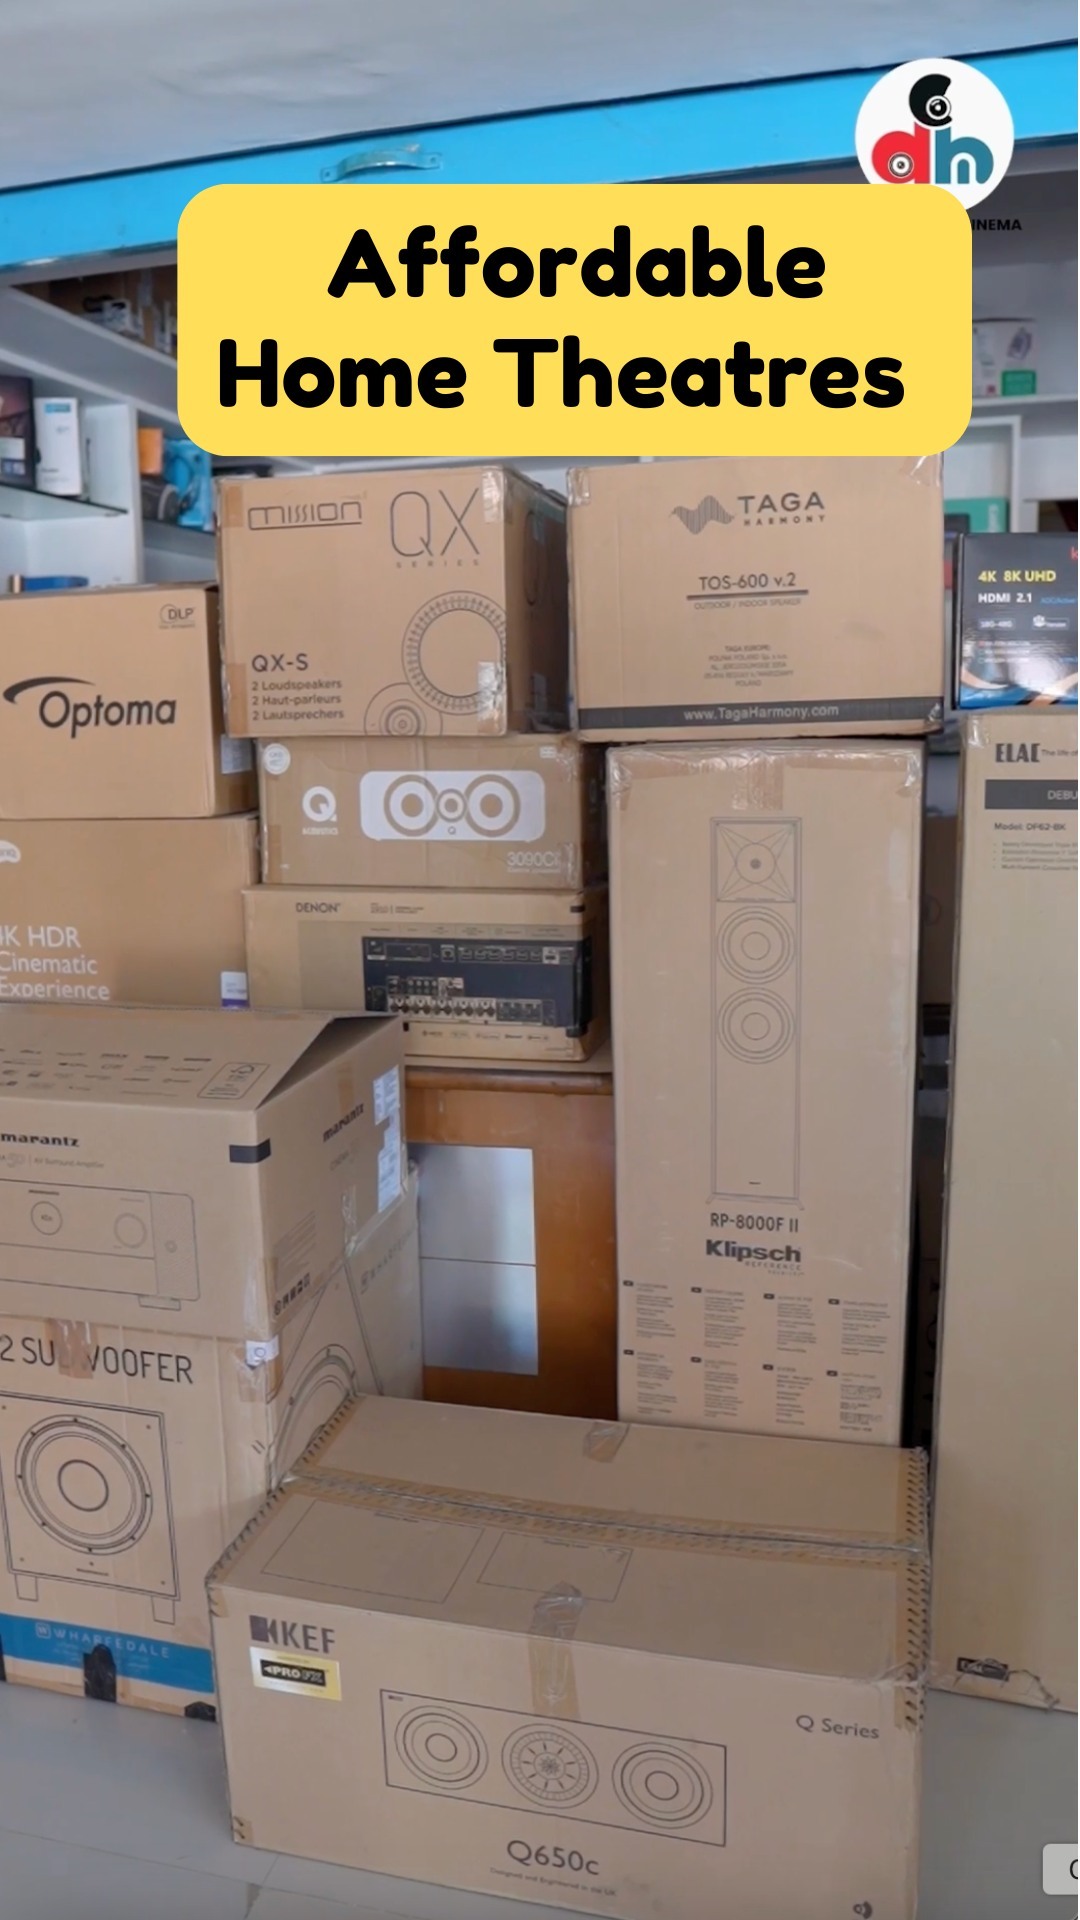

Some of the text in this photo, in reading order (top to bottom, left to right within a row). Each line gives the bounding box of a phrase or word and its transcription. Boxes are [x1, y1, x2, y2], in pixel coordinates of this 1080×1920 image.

[737, 491, 825, 514] TAGA
[247, 501, 364, 531] mission
[390, 487, 480, 557] QX
[743, 515, 825, 526] HARMONY
[396, 558, 480, 569] SERIES
[698, 572, 796, 591] TOS-600 v.2
[978, 570, 1057, 582] 4K 8K UHD
[694, 601, 731, 611] OUTDOOR
[738, 599, 768, 608] INDOOR
[770, 598, 802, 607] SPEAKER
[978, 592, 1011, 603] HDMI
[1016, 592, 1032, 603] 2.1
[168, 607, 194, 620] DLP
[252, 653, 309, 673] QX-S
[252, 679, 342, 693] 2 Loudspeakers
[252, 693, 342, 708] 2 Haut-parleurs
[39, 690, 176, 739] Optoma
[252, 708, 345, 722] 2 Lautsprechers
[683, 706, 839, 721] www.TagaHarmony.com
[1042, 749, 1055, 757] The
[302, 786, 337, 822] Q
[994, 823, 1023, 831] Model:
[295, 902, 337, 914] DENON
[28, 925, 81, 948] HDR
[0, 951, 98, 974] Cinematic
[0, 977, 110, 1001] Experience
[322, 1102, 365, 1144] marantz
[0, 1132, 80, 1148] marantz
[710, 1212, 784, 1232] RP-8000F
[705, 1239, 801, 1262] Klipsch
[744, 1261, 801, 1271] REFERENCE
[0, 1334, 15, 1362] 2
[53, 1627, 170, 1659] WHARFEDALE
[281, 1620, 335, 1654] KEF
[796, 1715, 879, 1739] Q Series
[506, 1839, 599, 1876] Q650c
[490, 1866, 523, 1880] Designed
[604, 1888, 617, 1897] UK
